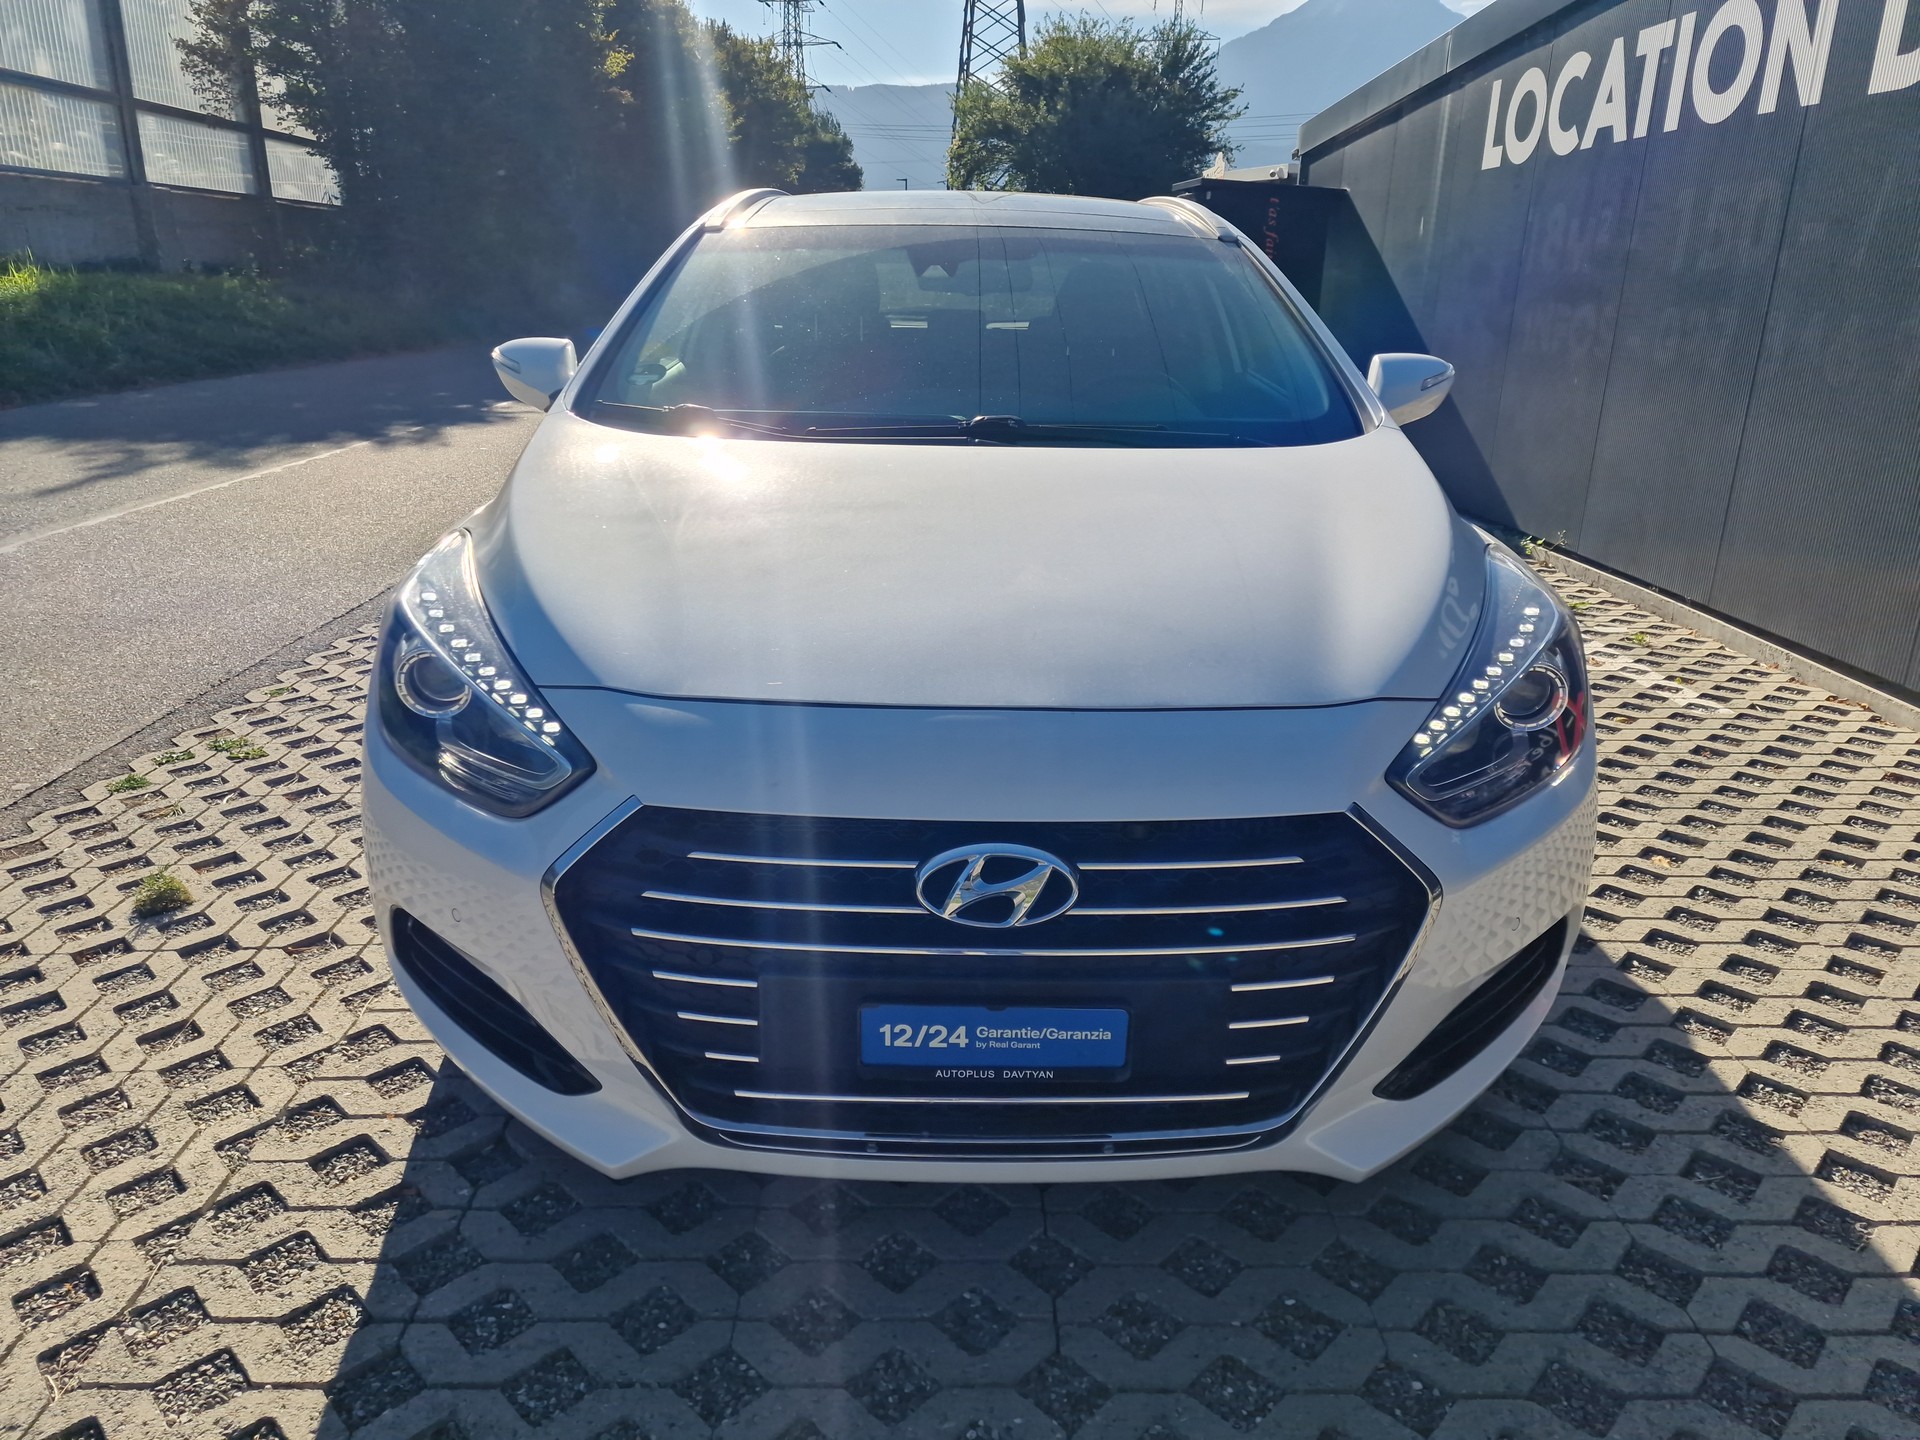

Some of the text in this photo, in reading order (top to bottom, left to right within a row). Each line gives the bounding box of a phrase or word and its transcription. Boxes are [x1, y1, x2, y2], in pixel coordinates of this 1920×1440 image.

[1481, 0, 1840, 170] LOCATION
[879, 1023, 969, 1048] 12/24
[976, 1026, 1112, 1040] Garantie/Garanzia
[975, 1041, 987, 1049] by
[989, 1041, 1008, 1049] Real
[935, 1069, 1054, 1079] AUTOPLUS DAVTYAN
